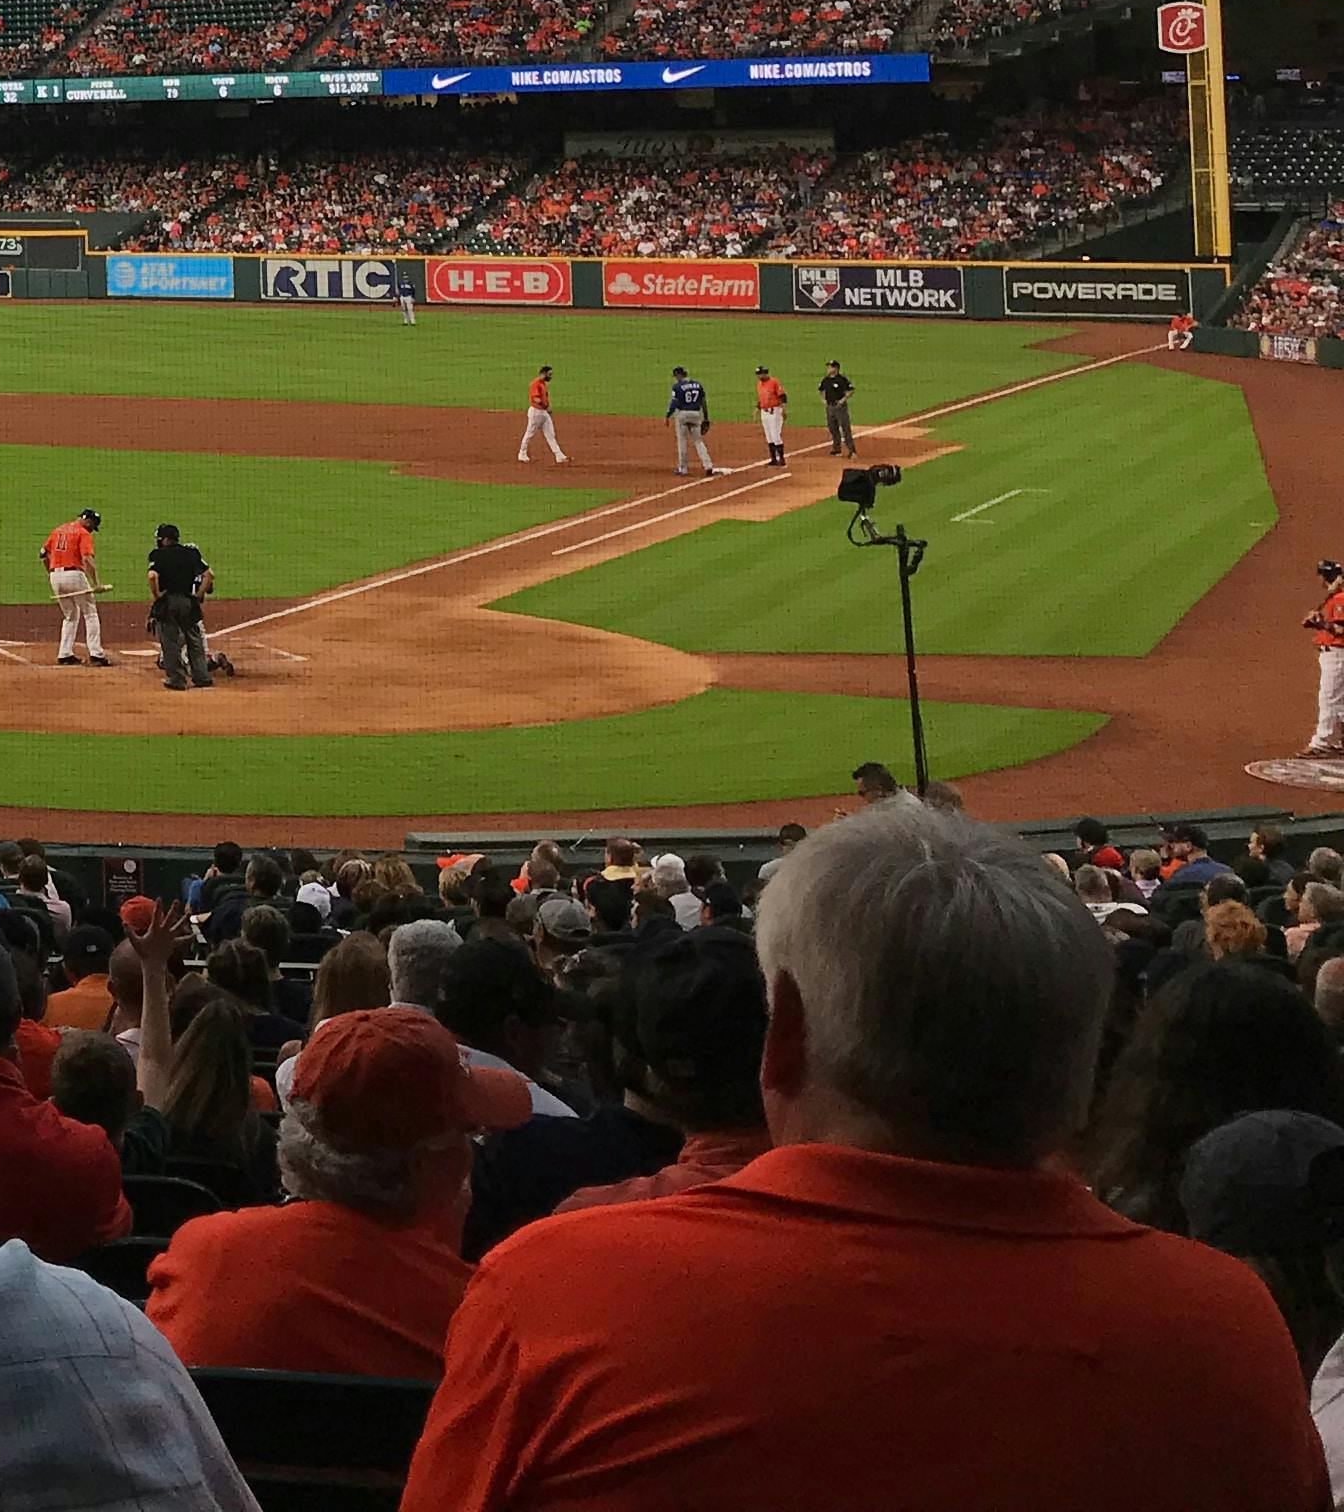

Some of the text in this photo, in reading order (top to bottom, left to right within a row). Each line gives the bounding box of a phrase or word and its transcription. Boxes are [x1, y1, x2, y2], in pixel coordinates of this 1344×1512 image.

[512, 61, 871, 86] NIKE.COM/ASTROS NIKE.COM/ASTROS
[266, 259, 391, 299] RTIC
[449, 271, 550, 293] H-E-B
[876, 269, 924, 287] MLB
[844, 288, 956, 307] NETWORK
[1012, 282, 1176, 301] POWERADE
[685, 390, 699, 403] 67
